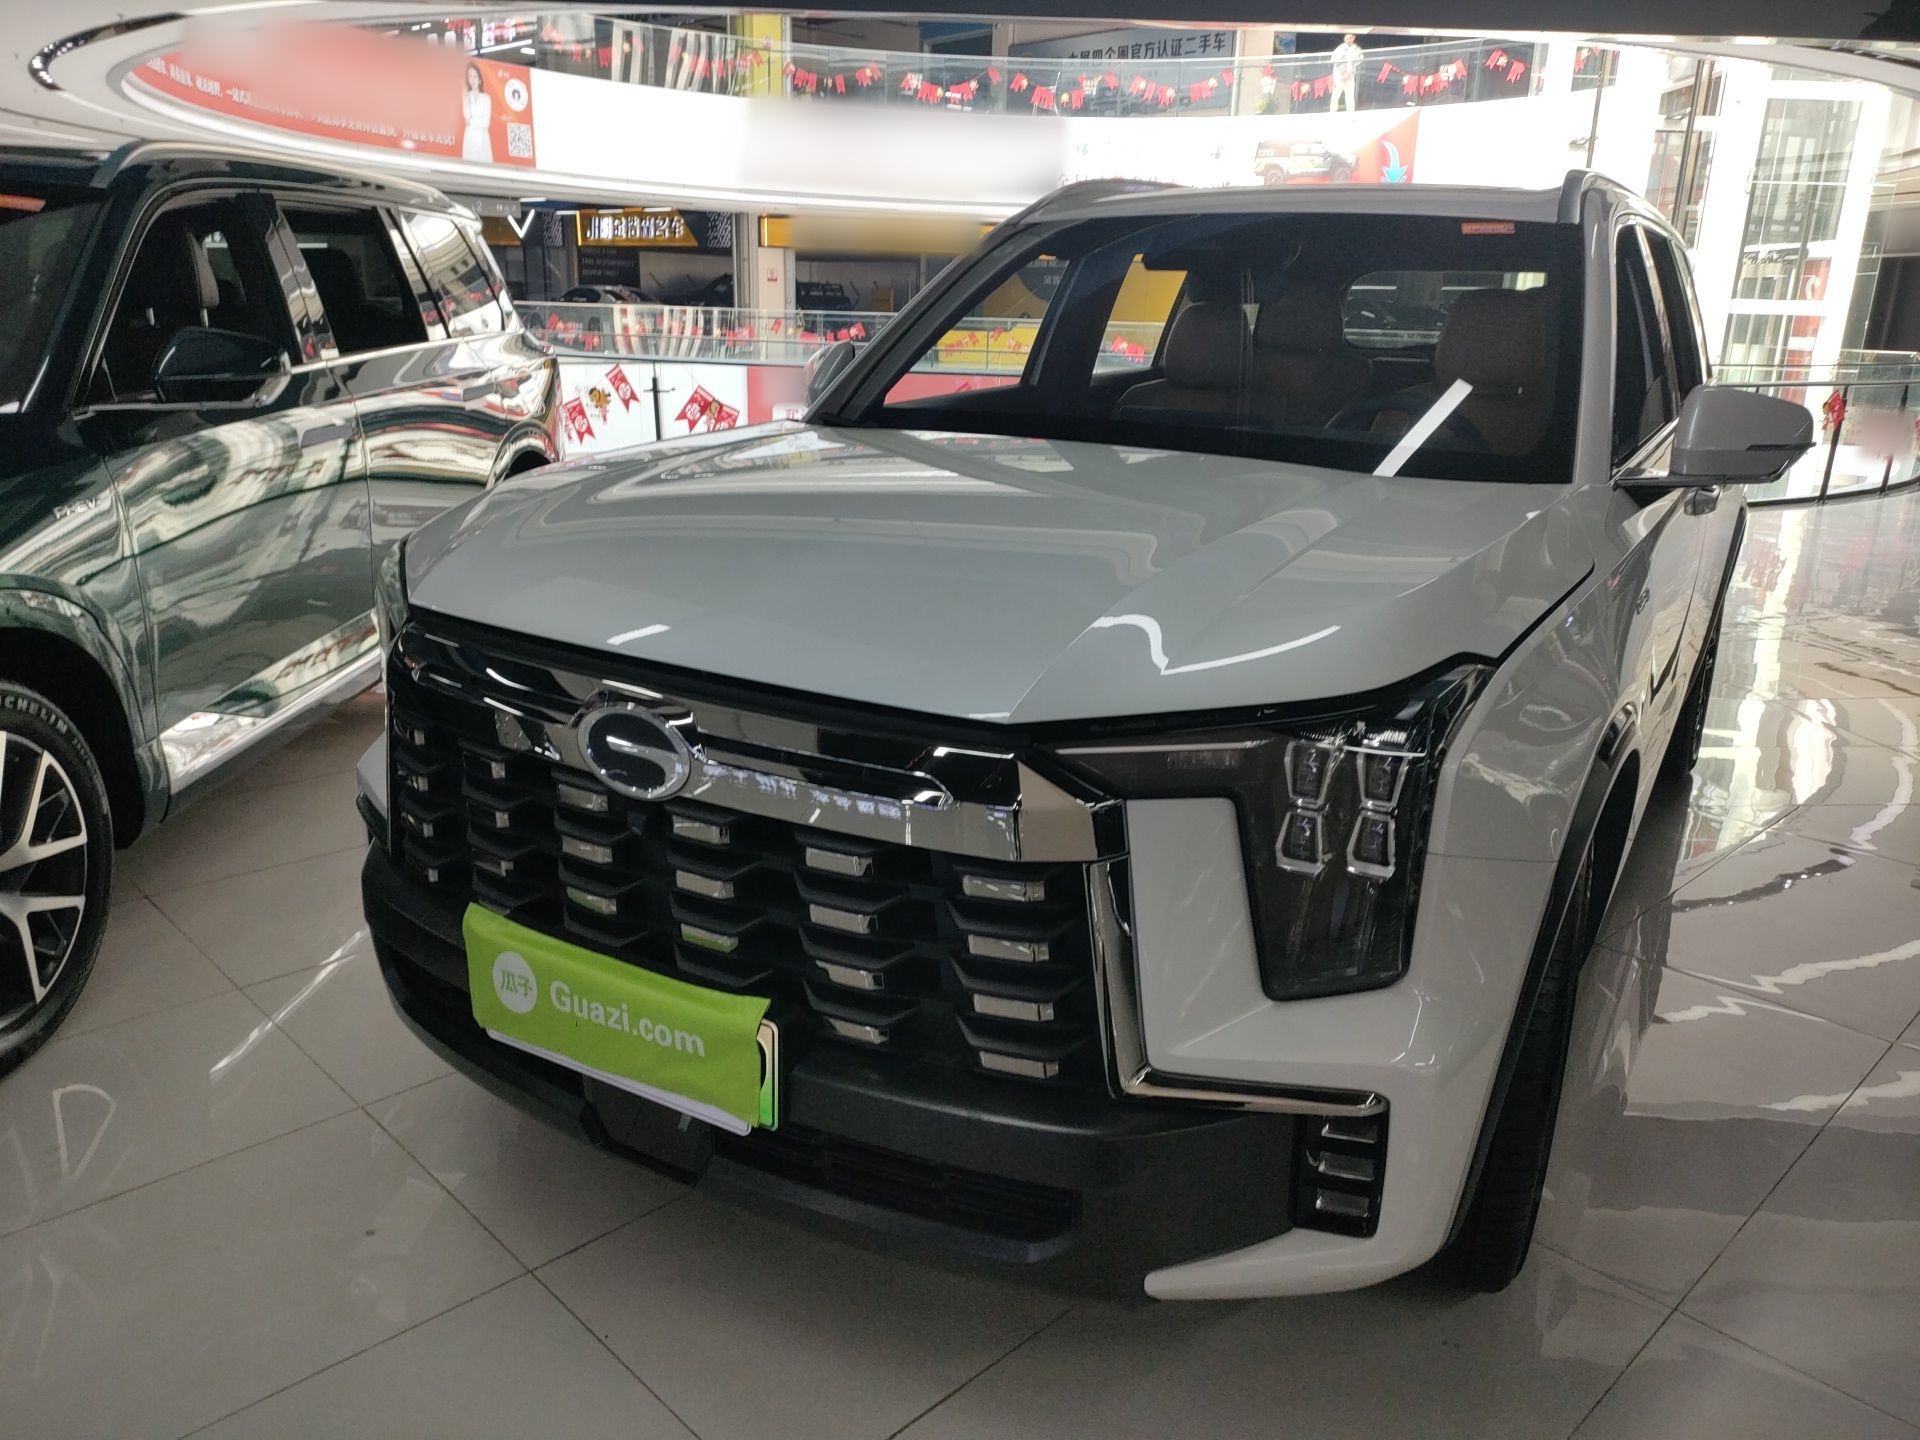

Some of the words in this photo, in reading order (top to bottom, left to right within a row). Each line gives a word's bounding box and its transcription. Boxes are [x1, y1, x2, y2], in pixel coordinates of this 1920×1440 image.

[0, 695, 68, 734] CHELIN
[500, 970, 533, 997] 瓜子
[550, 981, 706, 1058] Guazi.com
